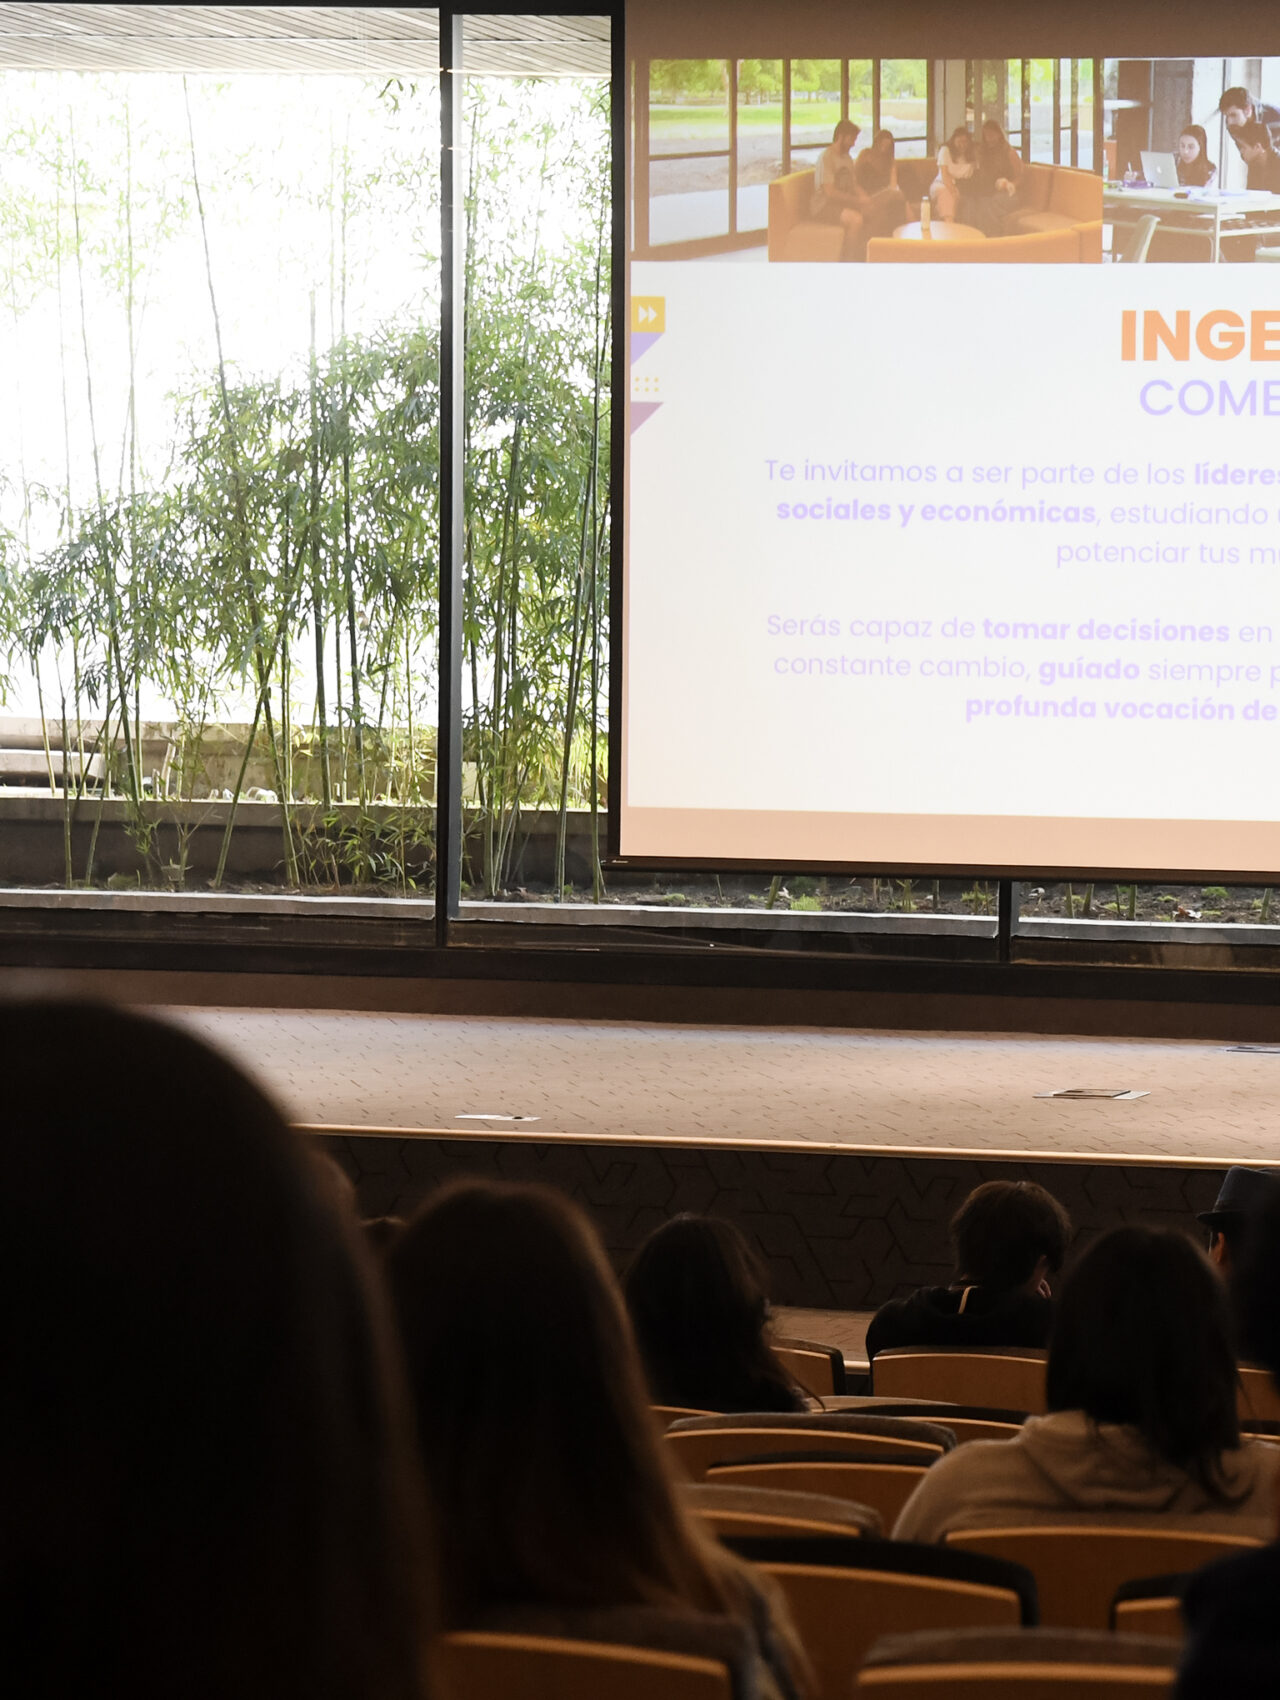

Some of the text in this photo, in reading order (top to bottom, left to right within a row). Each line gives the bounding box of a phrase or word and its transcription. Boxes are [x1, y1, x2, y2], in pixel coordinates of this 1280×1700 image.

[766, 459, 796, 480] Te
[804, 458, 938, 483] invitamos
[946, 466, 963, 483] a
[972, 465, 1013, 484] ser
[1022, 464, 1095, 490] parte
[1104, 462, 1139, 485] de
[1147, 462, 1184, 486] los
[777, 496, 891, 520] sociales
[898, 505, 915, 528] y
[920, 498, 1101, 526] económicas,
[1110, 501, 1269, 526] estudiando
[1057, 541, 1191, 568] potenciar
[1200, 544, 1240, 565] tus
[768, 614, 840, 637] Serás
[850, 619, 933, 643] capaz
[941, 616, 976, 639] de
[983, 616, 1071, 640] tomar
[1077, 616, 1230, 643] decisiones
[1238, 626, 1272, 643] en
[774, 656, 911, 676] constante
[920, 656, 1031, 680] cambio,
[1149, 659, 1262, 688] siempre
[966, 693, 1096, 723] profunda
[1104, 696, 1235, 720] vocación
[1242, 699, 1279, 722] de
